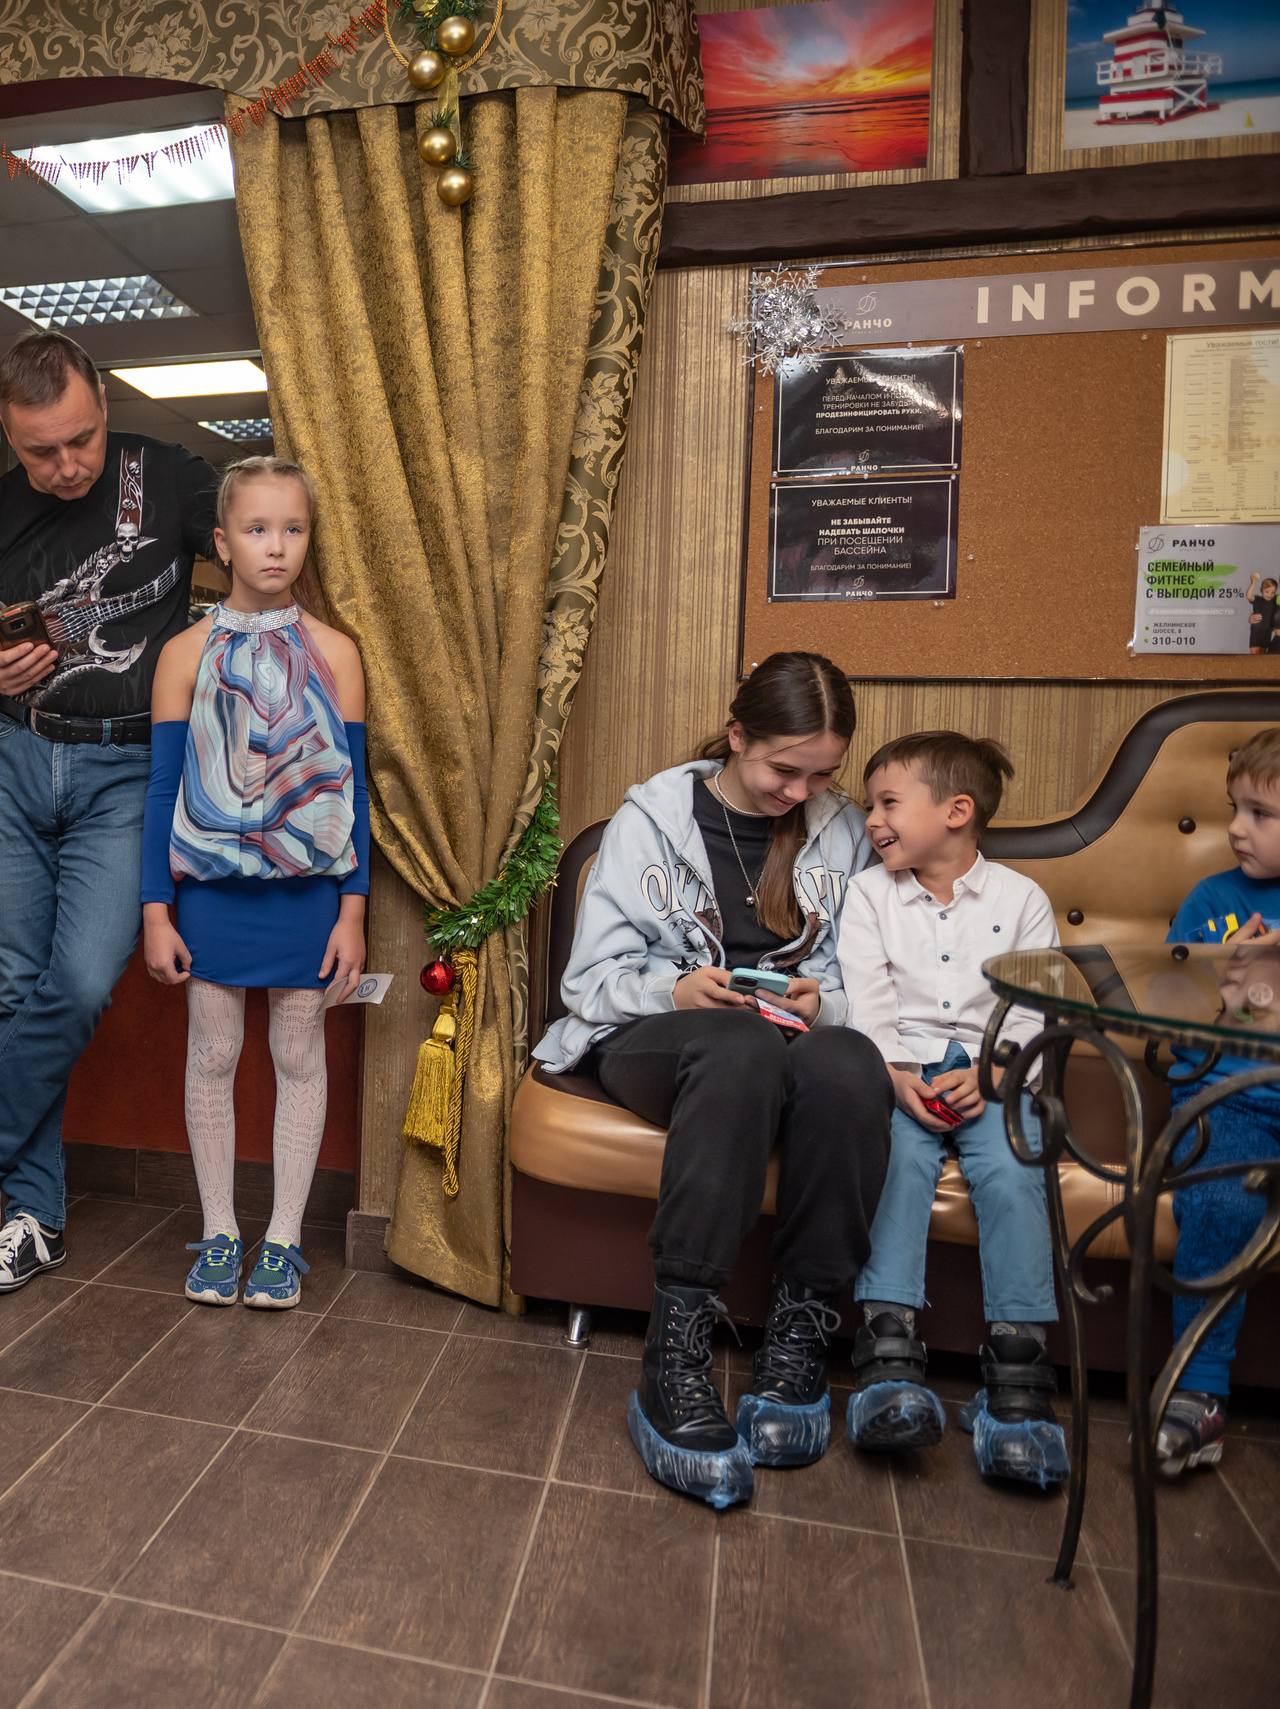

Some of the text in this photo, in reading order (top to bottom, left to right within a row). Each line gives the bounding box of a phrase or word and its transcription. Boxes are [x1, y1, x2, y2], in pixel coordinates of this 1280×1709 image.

[976, 269, 1280, 324] INFORM
[844, 318, 892, 330] РАНЧО
[822, 394, 845, 402] ПЕРЕД
[846, 393, 882, 401] НАЧАЛОМ
[822, 402, 869, 410] ТРЕНИРОВКИ
[816, 410, 900, 419] ПРОДЕЗИНФИЦИРОВАТЬ
[815, 426, 863, 435] БЛАГОДАРИМ
[876, 424, 924, 432] ПОНИМАНИЕ!
[850, 464, 878, 472] РАНЧО
[811, 496, 913, 507] УВАЖАЕМЫЕ КЛИЕНТЫ!
[831, 516, 892, 526] НЕ ЗАБЫВАЙТЕ
[819, 526, 905, 536] НАДЕВАТЬ ШАПОЧКИ
[817, 536, 903, 546] ПРИ ПОСЕЩЕНИИ
[1172, 538, 1216, 548] РАНЧО
[834, 546, 887, 555] БАССЕЙНА
[810, 563, 856, 571] БЛАГОДАРИМ
[867, 562, 912, 570] ПОНИМАНИЕ!
[1147, 559, 1214, 573] СЕМЕЙНЫЙ
[1146, 575, 1195, 586] ФИТНЕС
[1146, 586, 1245, 600] С ВЫГОДОЙ 25%
[1152, 636, 1196, 646] 310-010
